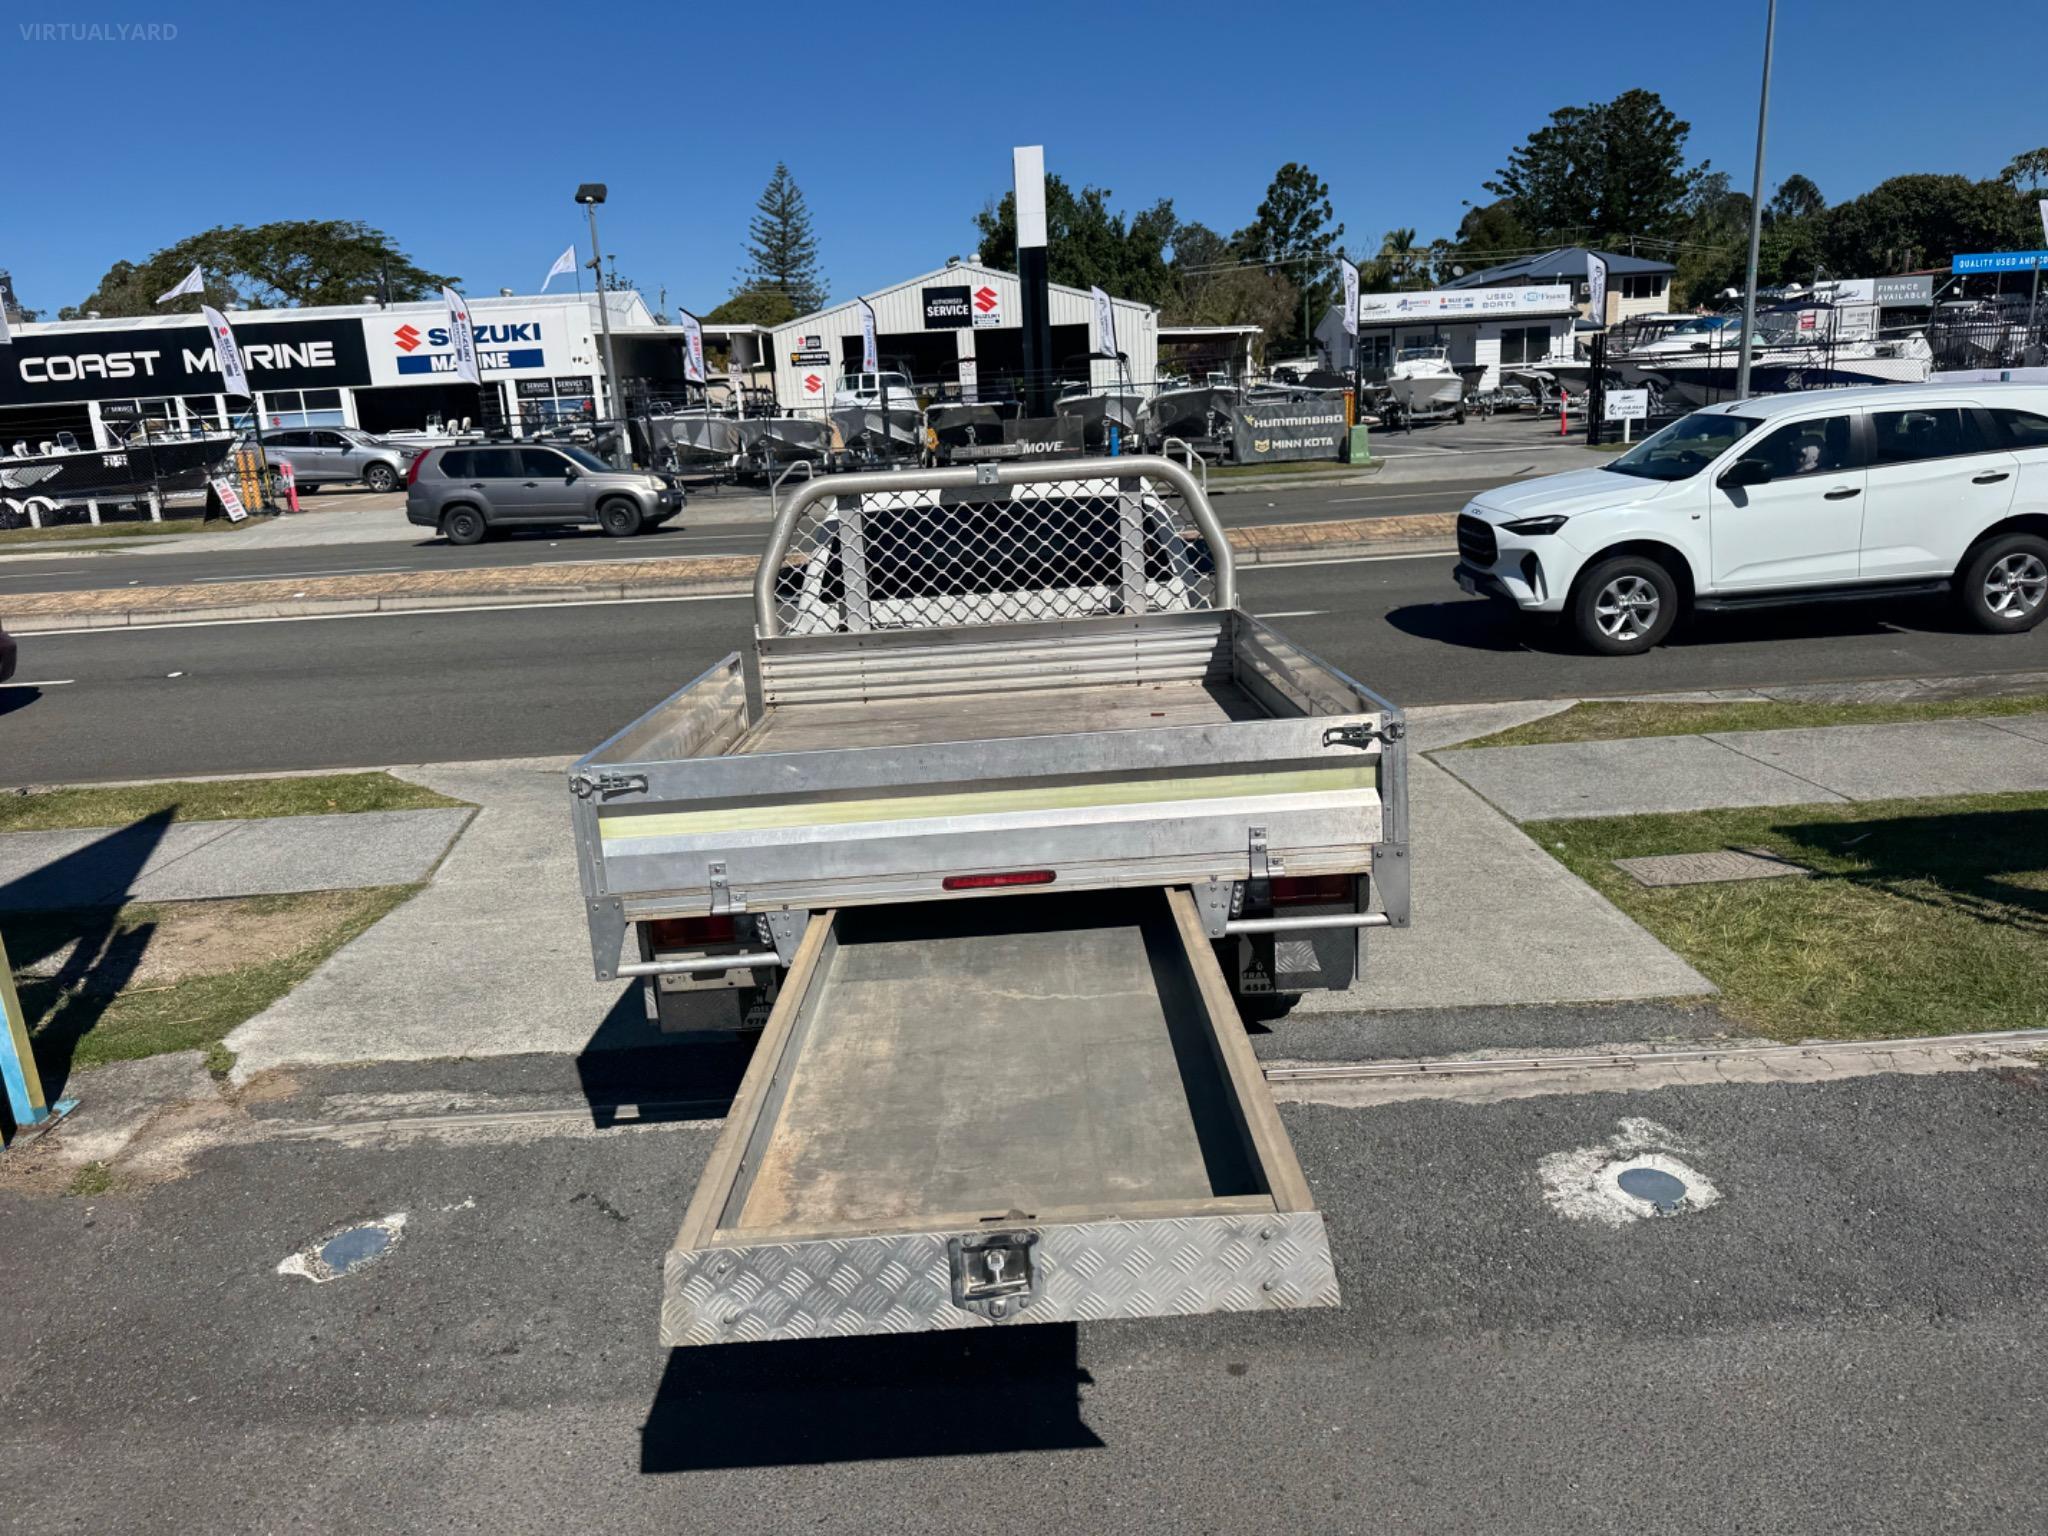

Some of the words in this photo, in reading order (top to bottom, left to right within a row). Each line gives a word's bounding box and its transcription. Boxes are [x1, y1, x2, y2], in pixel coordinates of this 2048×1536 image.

[1959, 258, 1993, 269] QUALITY
[1996, 257, 2016, 266] USED
[1878, 283, 1918, 292] FINANCE
[1486, 292, 1514, 301] USED
[1877, 291, 1927, 301] AVAILABLE
[926, 304, 969, 317] SERVICE
[1482, 300, 1517, 309] BOATS
[428, 322, 542, 347] SZUKI
[182, 341, 336, 375] MRINE
[430, 351, 512, 372] MAINE
[19, 350, 161, 384] COAST
[557, 380, 585, 388] SERVICE
[1254, 414, 1344, 429] HUMMINBIRD
[1022, 441, 1065, 454] MOVE
[1271, 439, 1302, 450] MINN
[1303, 436, 1335, 448] KOTA
